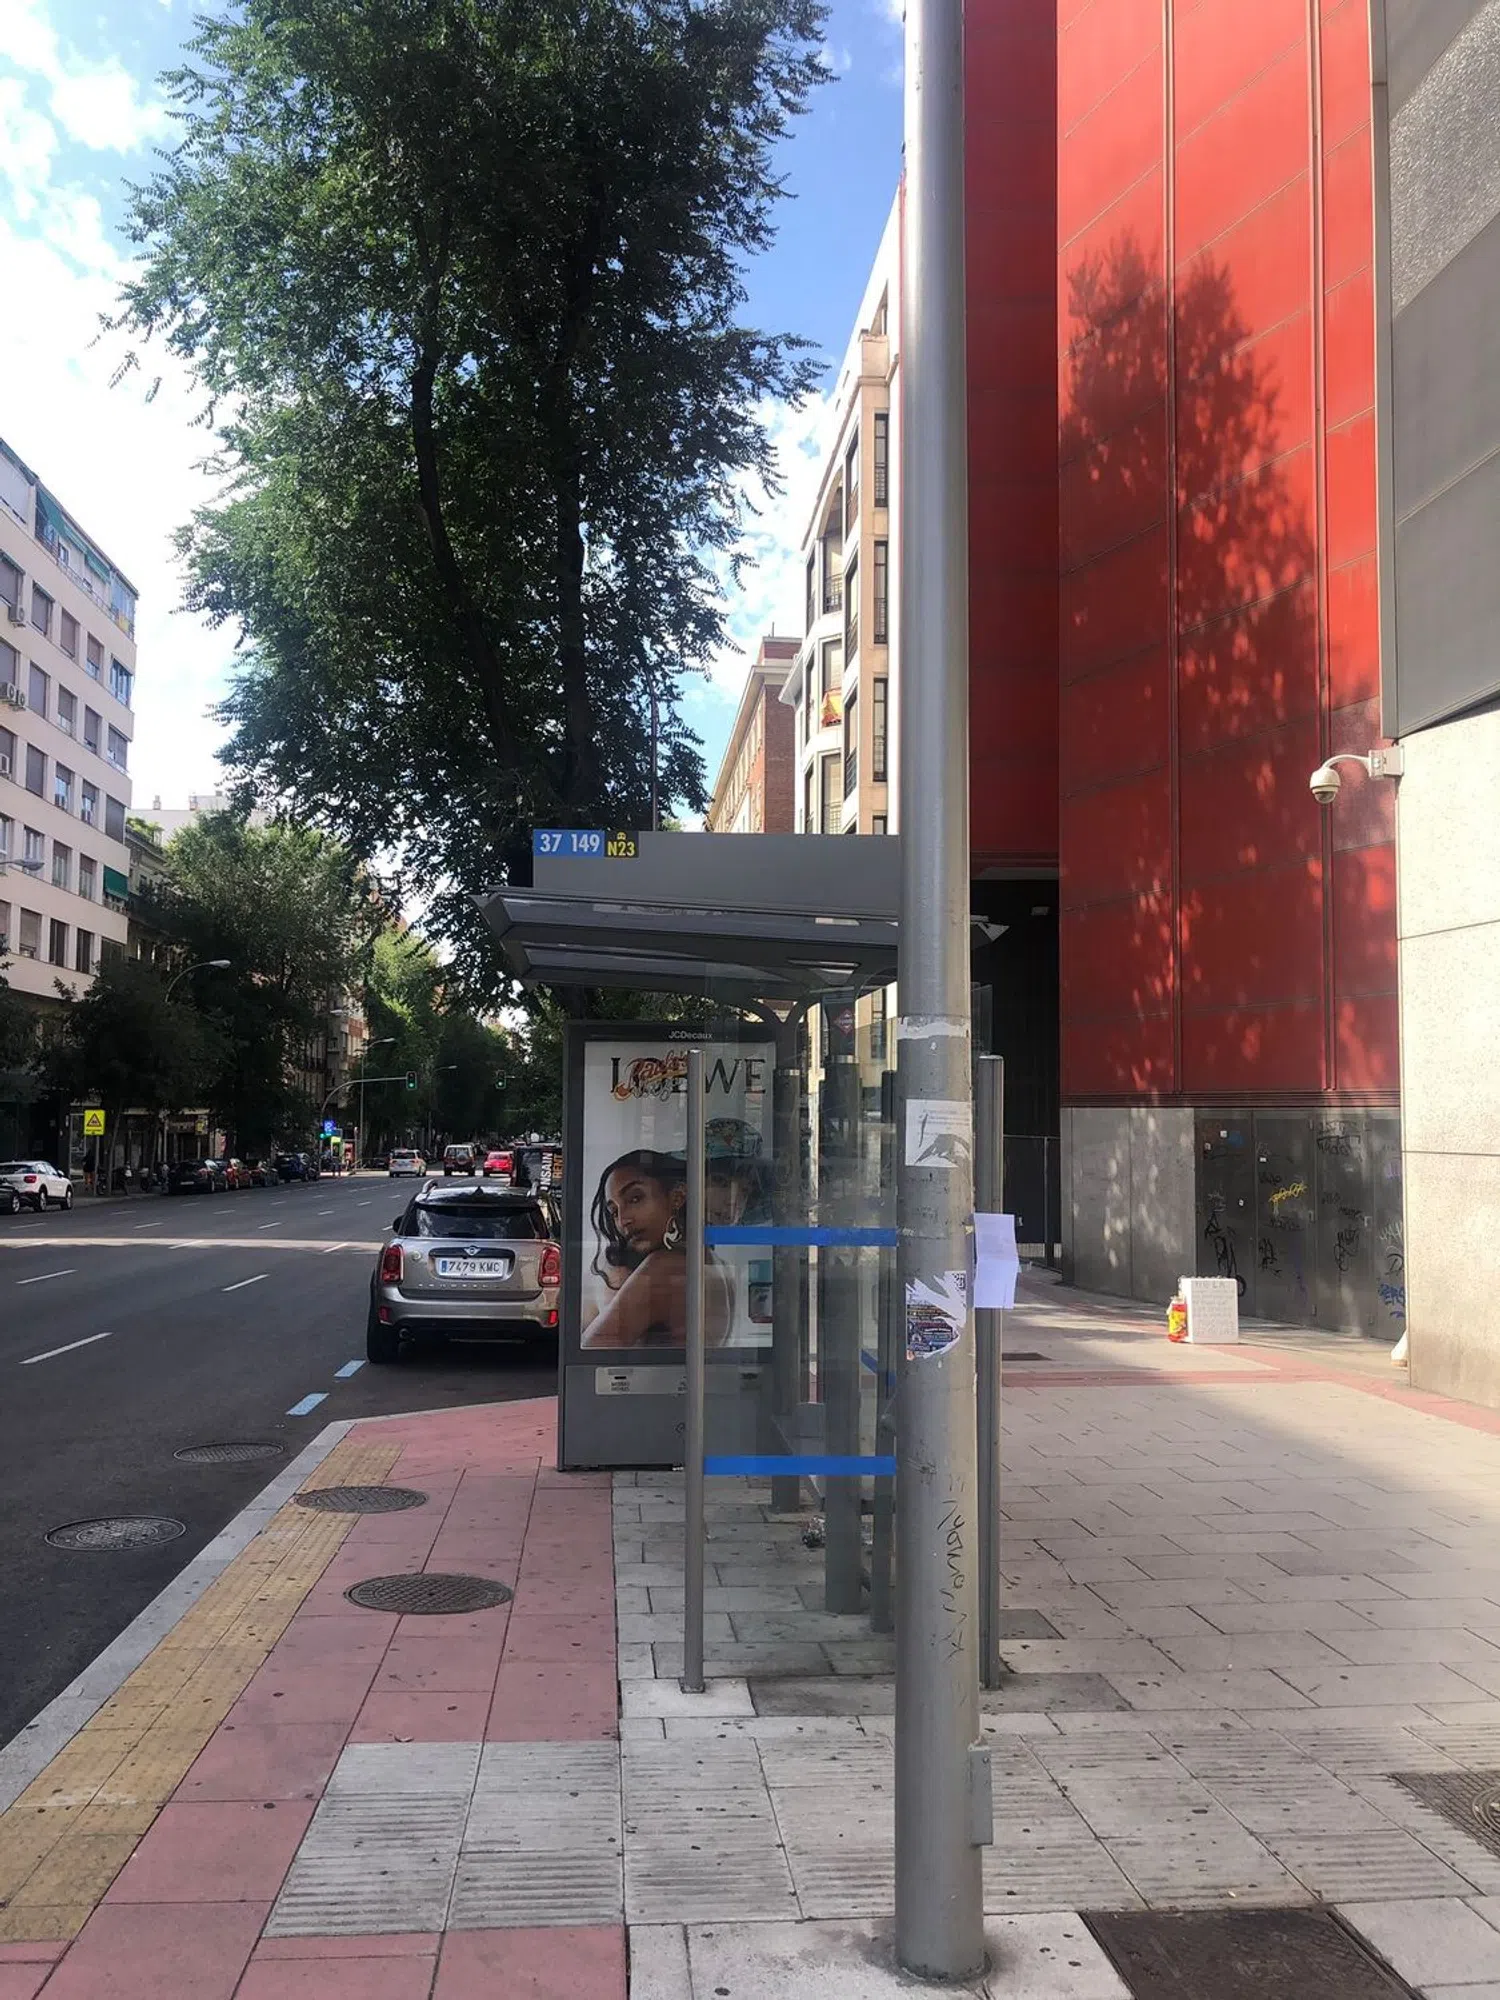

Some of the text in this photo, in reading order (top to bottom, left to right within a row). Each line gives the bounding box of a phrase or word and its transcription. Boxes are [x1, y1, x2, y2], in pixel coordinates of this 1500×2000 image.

[540, 834, 600, 852] 37 149
[607, 841, 636, 857] N23
[668, 1030, 713, 1039] JCDecaux
[610, 1056, 767, 1095] LOWE
[449, 1261, 500, 1272] 7479 KMC
